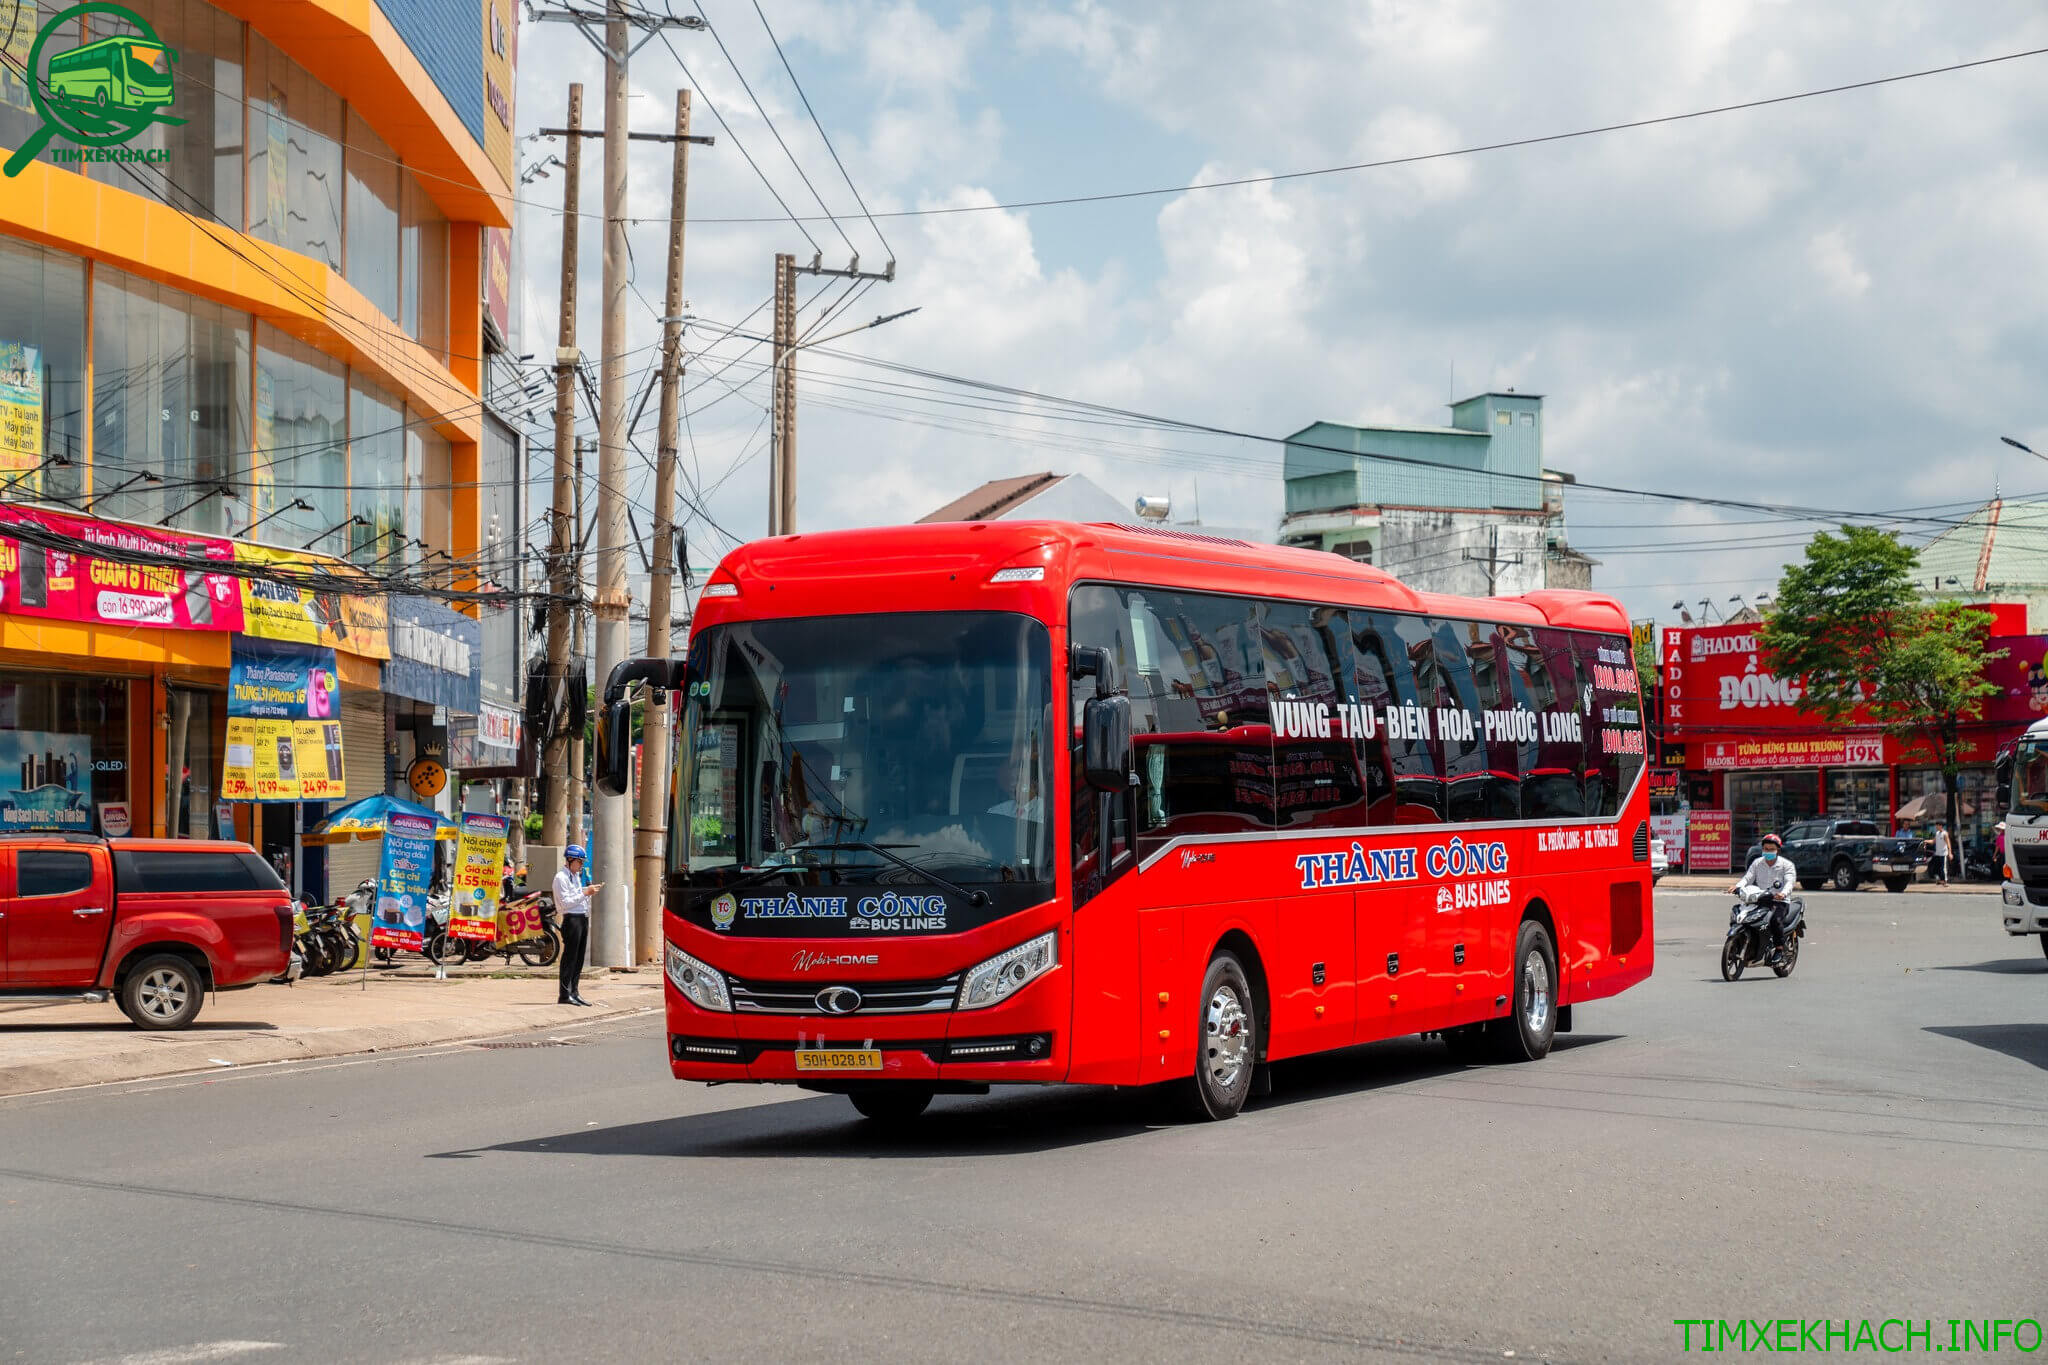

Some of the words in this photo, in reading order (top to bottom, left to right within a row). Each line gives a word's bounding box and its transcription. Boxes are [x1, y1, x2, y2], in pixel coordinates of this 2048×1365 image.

[1703, 634, 1758, 655] HADOKI
[263, 666, 298, 682] Panasonic
[1270, 694, 1331, 739] VŨNG
[1543, 711, 1582, 743] LONG
[1786, 741, 1808, 753] KHAI
[1848, 746, 1881, 762] 19K
[96, 761, 123, 771] QLED
[1707, 757, 1735, 766] HADOKI
[465, 864, 480, 874] Giá
[1295, 841, 1418, 889] THÀNH
[1426, 835, 1510, 878] CÔNG
[389, 868, 405, 879] Giá
[381, 879, 406, 894] 1,55
[407, 883, 427, 897] triệu
[456, 874, 480, 887] 1,55
[481, 878, 500, 889] triệu
[1455, 883, 1478, 908] BUS
[1480, 879, 1511, 904] LINES
[718, 902, 730, 913] TC
[740, 892, 847, 918] THÀNH
[857, 891, 947, 917] CÔNG
[871, 918, 900, 930] BUS
[903, 917, 947, 930] LINES
[803, 1054, 874, 1067] 50H-028.81
